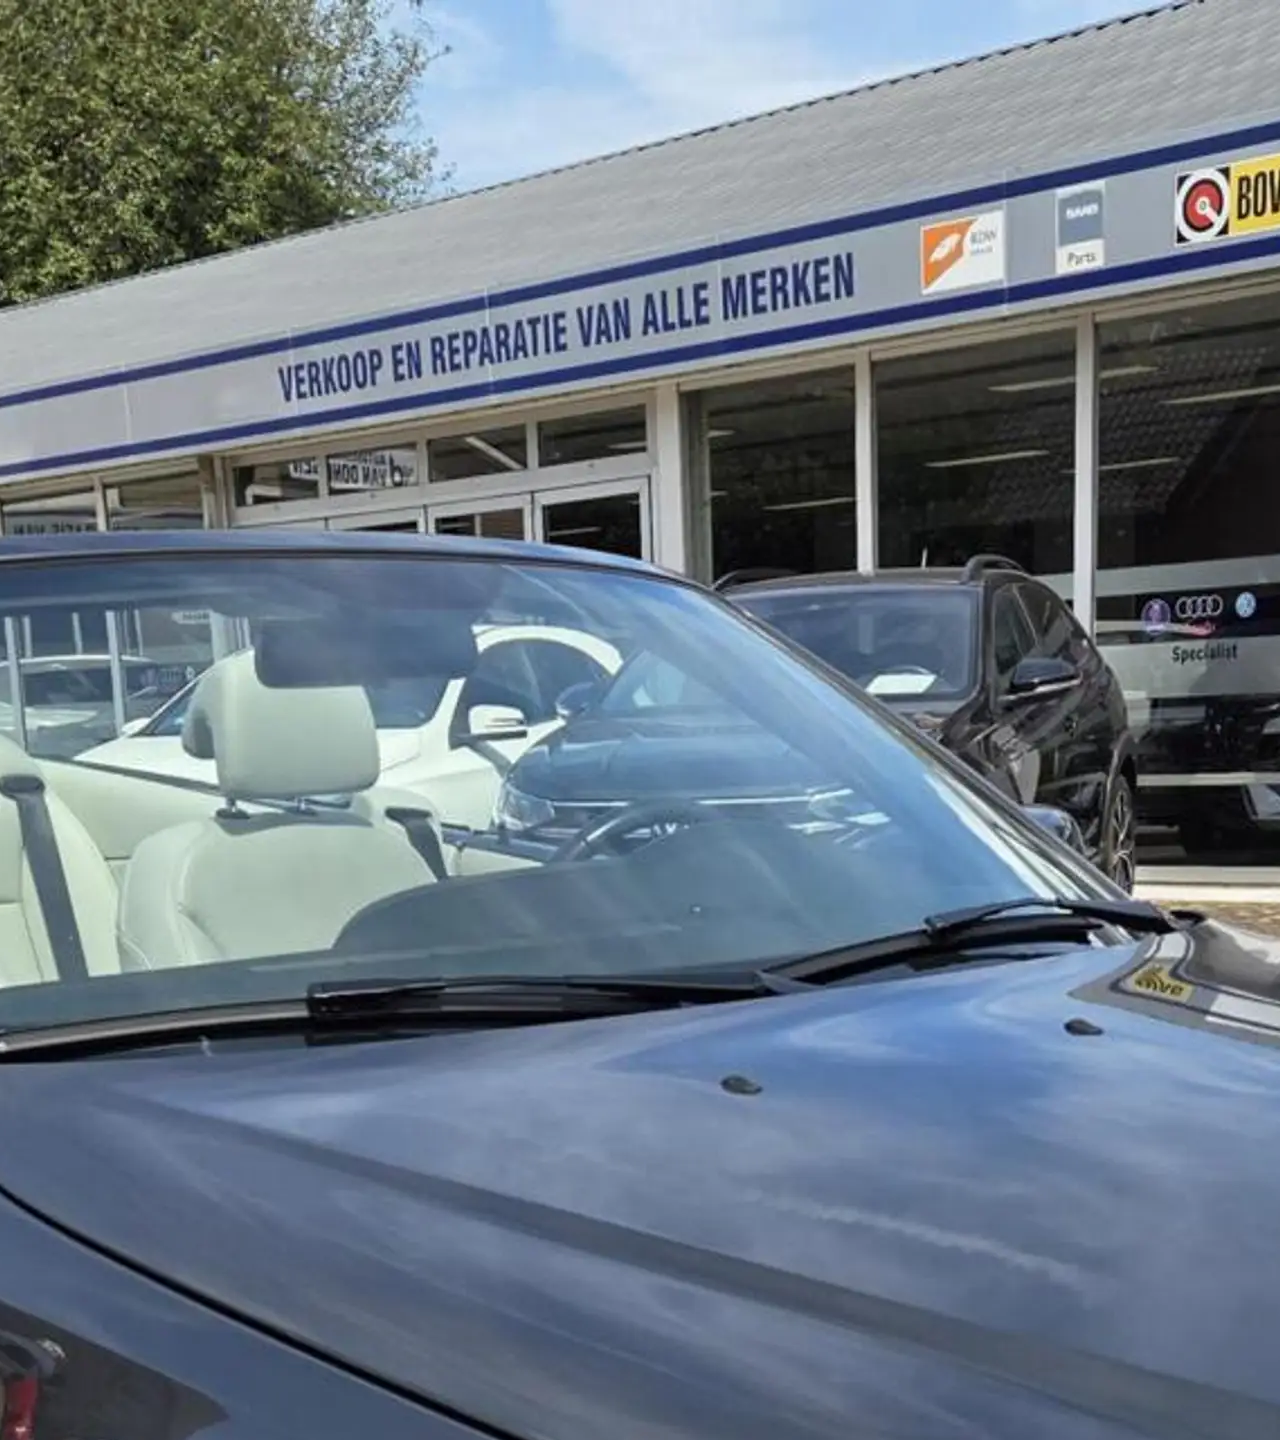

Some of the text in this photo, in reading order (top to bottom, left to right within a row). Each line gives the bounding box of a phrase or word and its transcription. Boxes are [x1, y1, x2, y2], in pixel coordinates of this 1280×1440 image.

[1067, 251, 1098, 266] Parts
[278, 252, 855, 402] VERKOOP EN REPARATIE VAN ALLE MERKEN
[1171, 642, 1238, 665] Specialist
